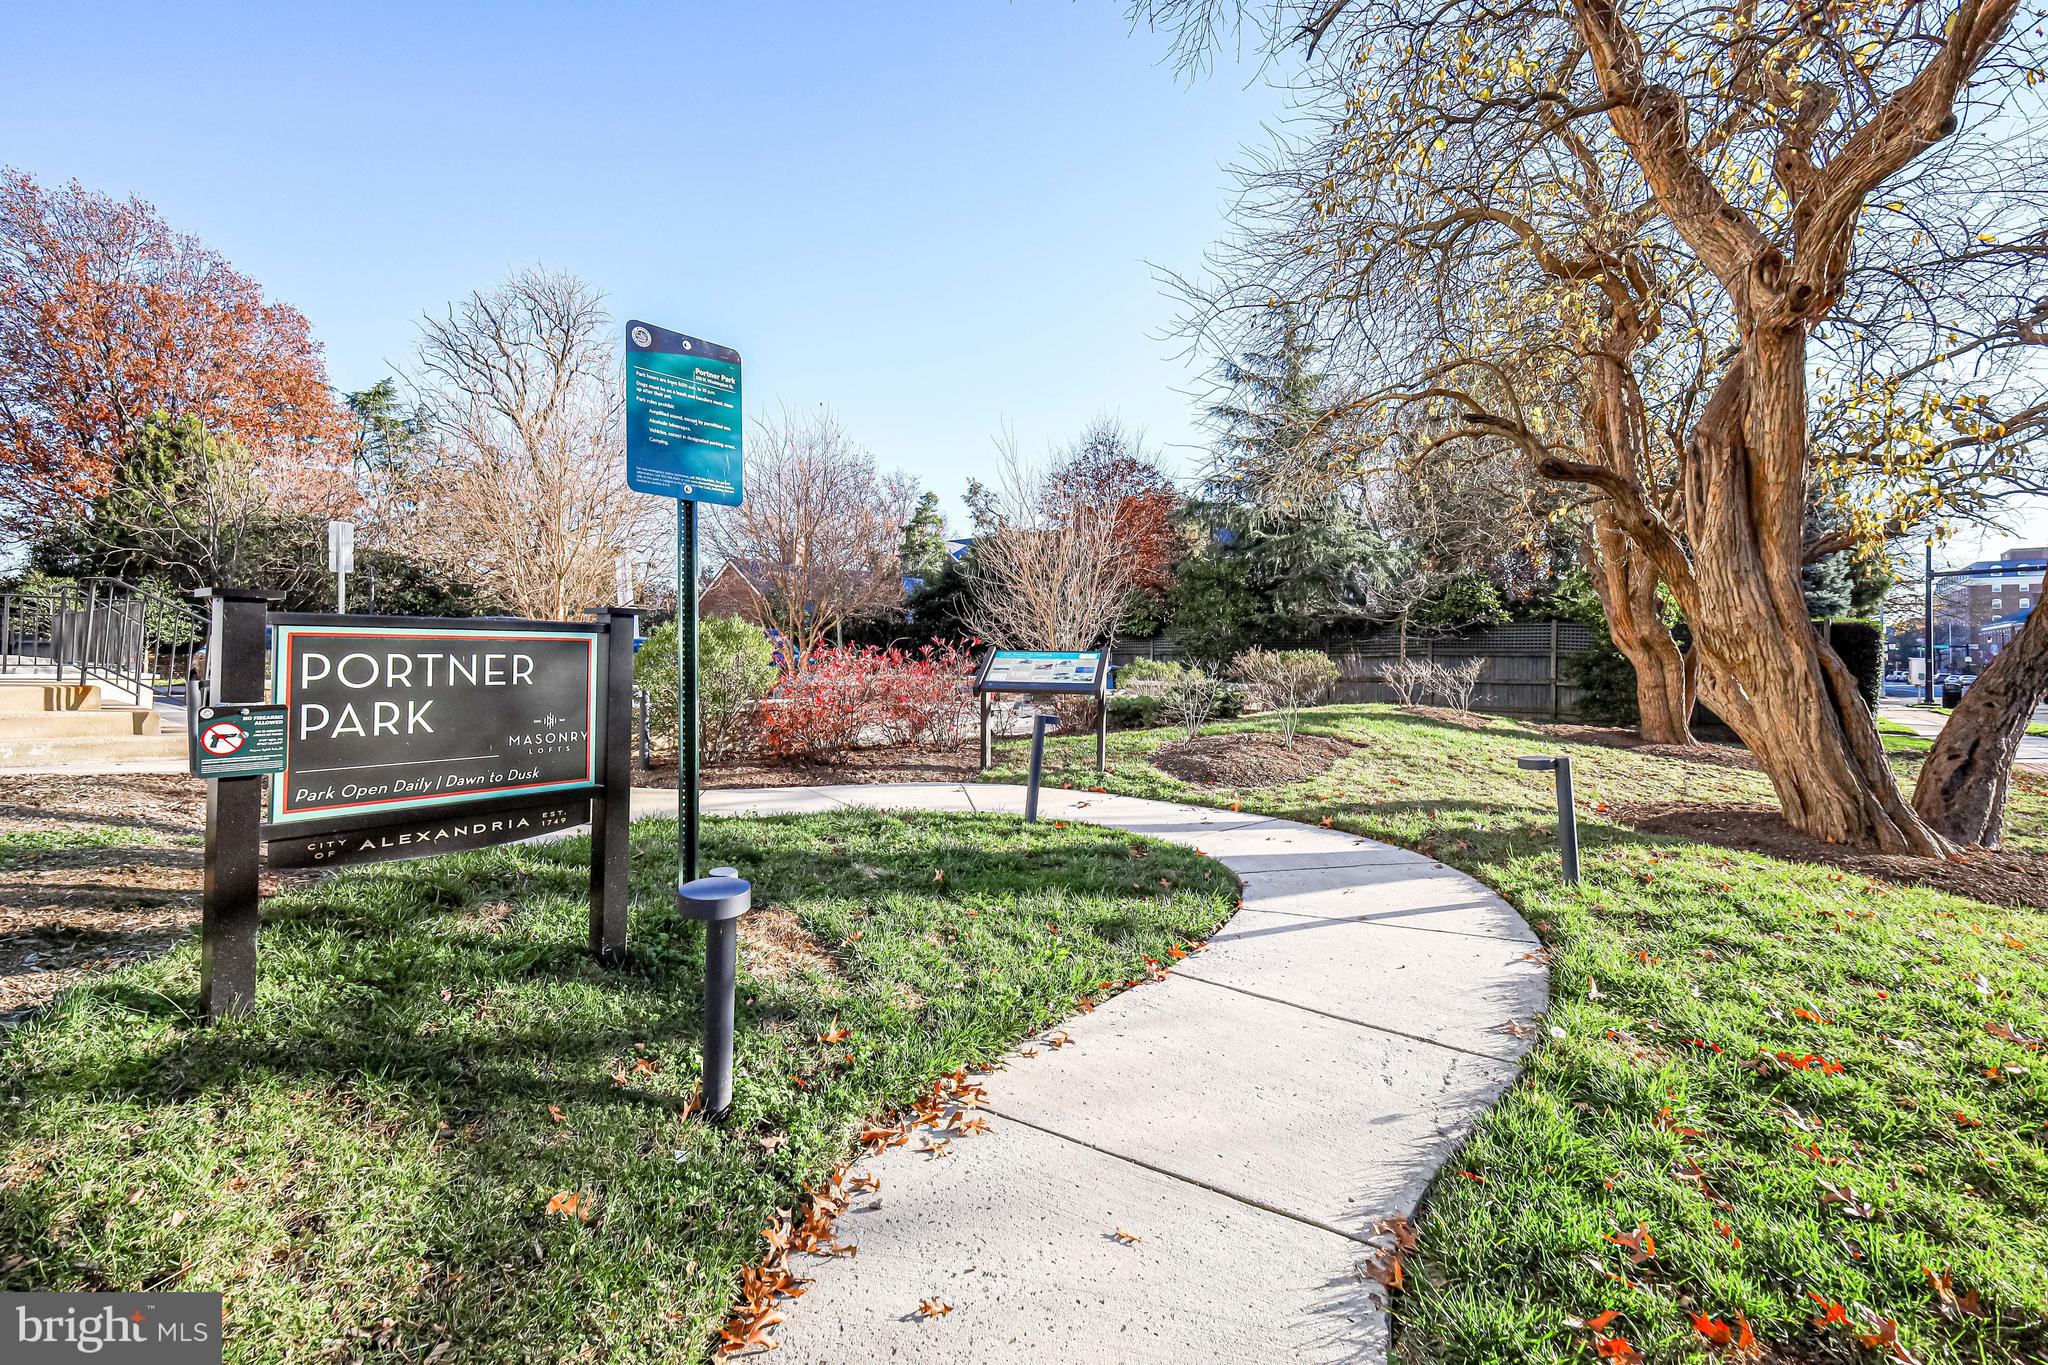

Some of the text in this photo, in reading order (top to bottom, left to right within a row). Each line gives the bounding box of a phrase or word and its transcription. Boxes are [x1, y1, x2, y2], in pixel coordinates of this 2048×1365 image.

[636, 370, 646, 378] Park
[695, 367, 720, 380] Portner
[720, 374, 736, 385] Park
[636, 380, 648, 388] Dogs
[301, 651, 536, 690] PORTNER
[300, 699, 435, 741] PARK
[508, 730, 588, 747] MASONRY
[528, 745, 571, 755] LOFTS
[295, 766, 540, 803] Park Open Daily Dawn to Dusk
[542, 810, 568, 818] EST.
[541, 817, 567, 827] 1749
[358, 817, 530, 852] ALEXANDRIA
[307, 839, 348, 851] CITY
[314, 850, 336, 860] OF
